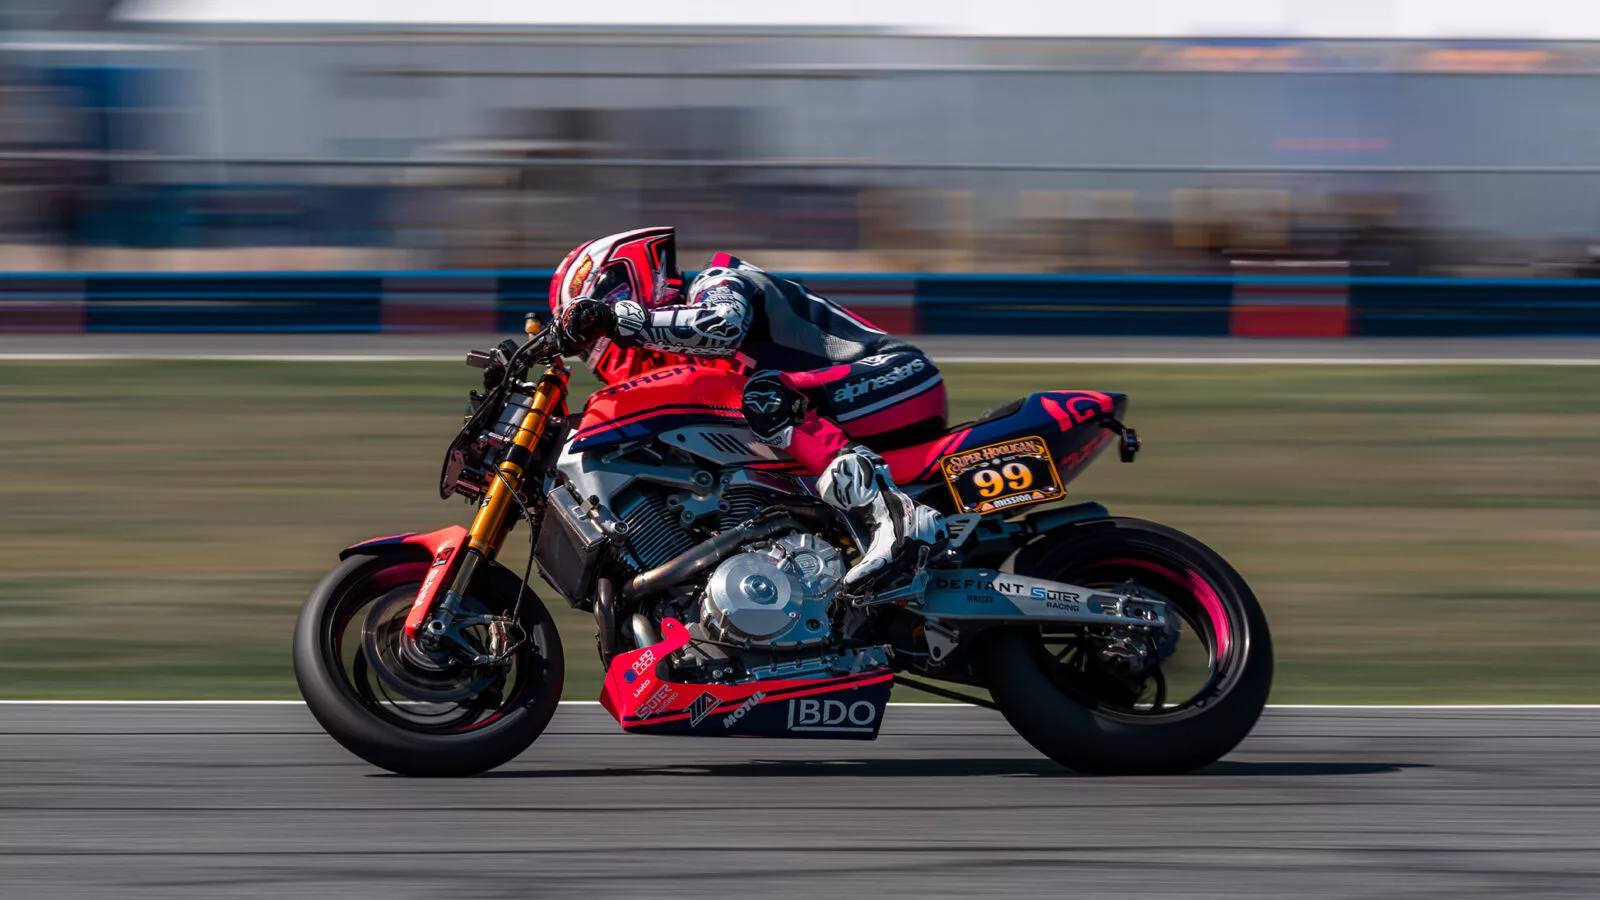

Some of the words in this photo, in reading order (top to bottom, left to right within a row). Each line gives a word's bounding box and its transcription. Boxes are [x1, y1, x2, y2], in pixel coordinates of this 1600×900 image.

[833, 358, 925, 403] alpinestars
[950, 453, 983, 472] SUPER
[982, 441, 1038, 460] HOOLIGAN
[973, 462, 1033, 498] 99
[937, 579, 1024, 594] DEFIANT
[1030, 586, 1080, 603] SUTER
[1046, 602, 1080, 612] RACING
[631, 649, 653, 671] QUAD
[636, 654, 657, 676] LOCK
[635, 683, 673, 721] SUTER
[722, 690, 766, 729] MOTUL
[799, 699, 876, 726] BDO
